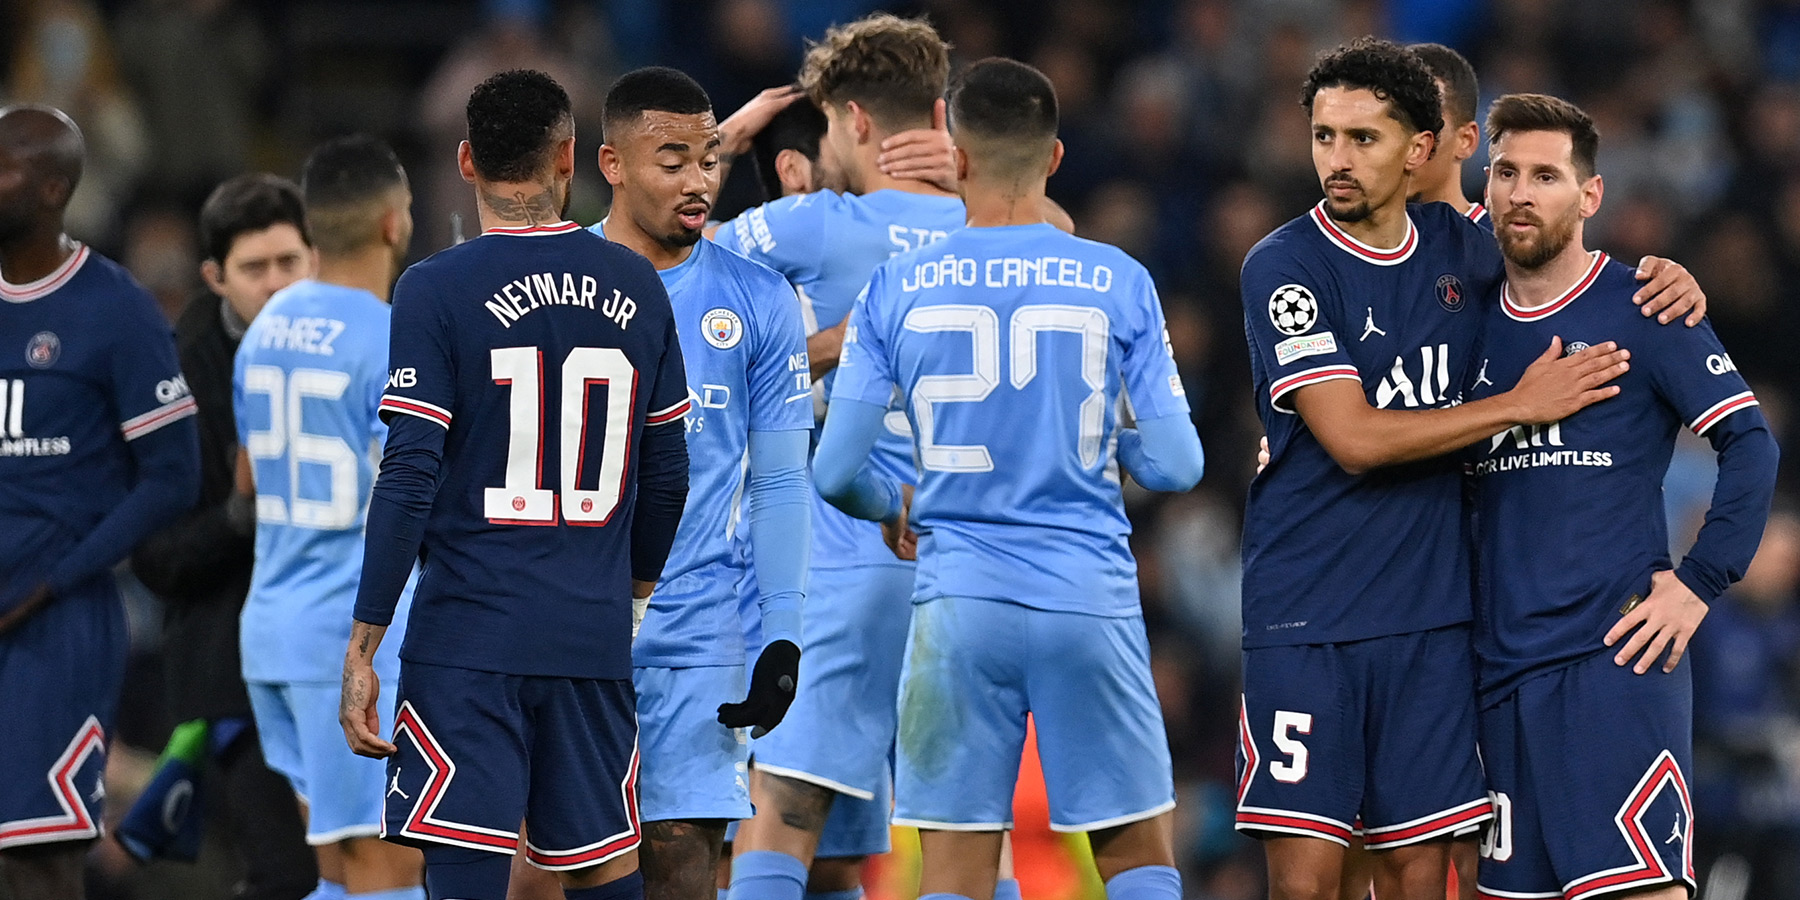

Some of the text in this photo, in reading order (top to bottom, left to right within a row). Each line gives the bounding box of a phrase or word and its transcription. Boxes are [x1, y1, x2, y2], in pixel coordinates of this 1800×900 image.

[484, 272, 637, 331] NEYMAR JR
[902, 254, 1113, 293] JOÃO CANCELO
[1278, 338, 1333, 357] FOUNDATION
[903, 304, 1110, 473] 27
[244, 365, 359, 531] 26
[484, 346, 640, 527] 10
[1500, 453, 1531, 471] LIVE
[1531, 450, 1613, 468] LIMITLESS
[1269, 710, 1313, 784] 5
